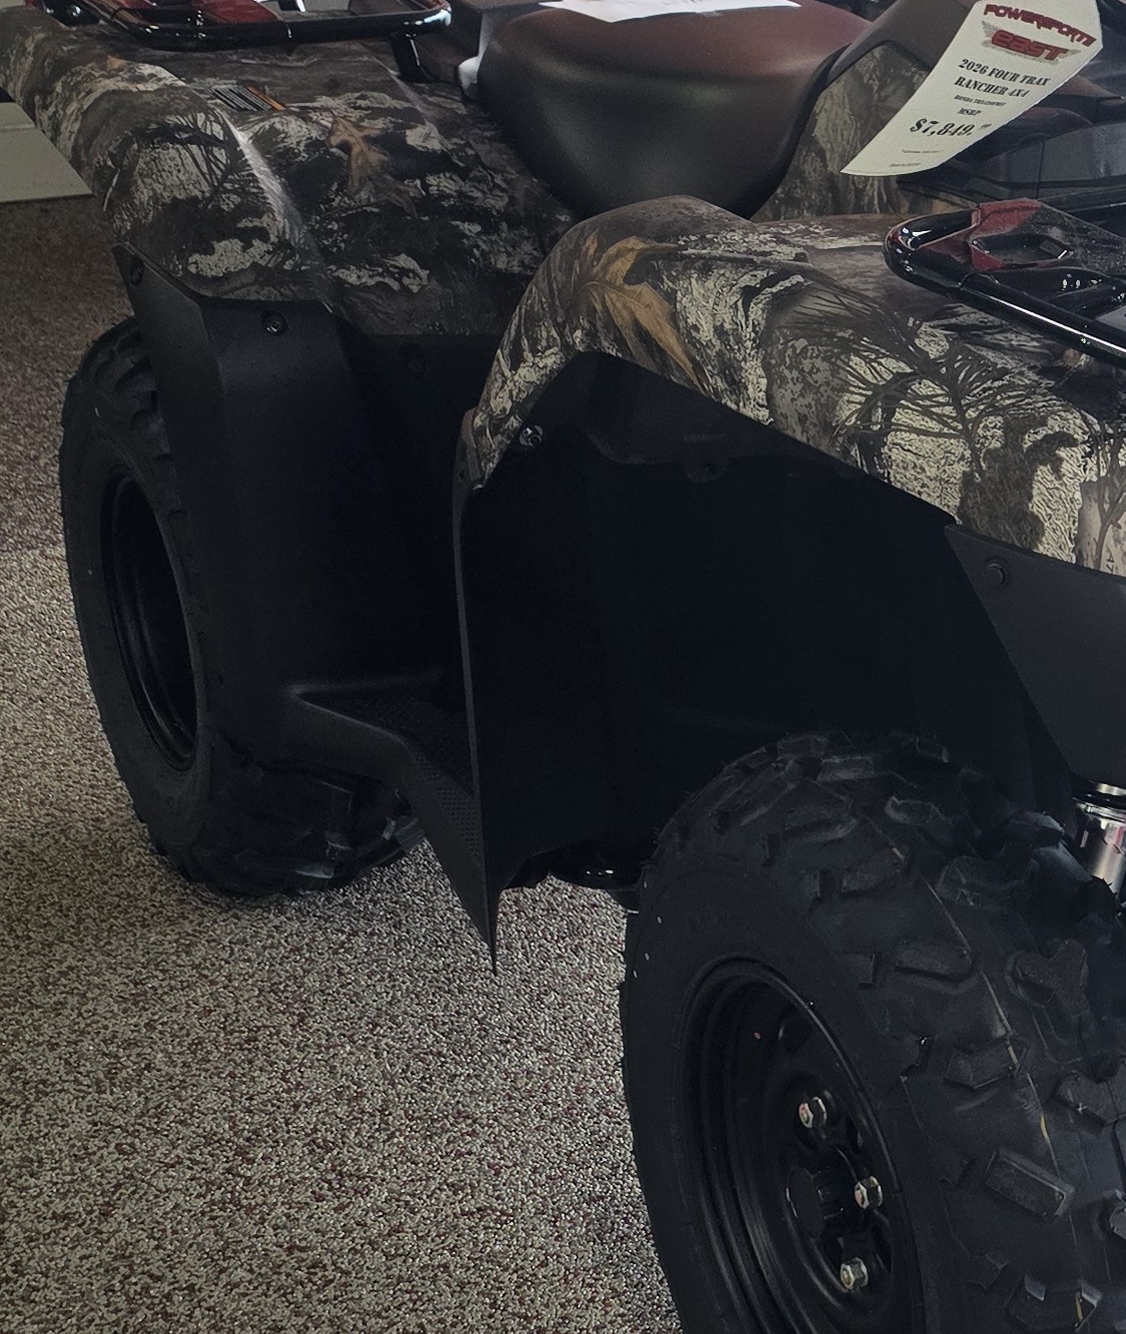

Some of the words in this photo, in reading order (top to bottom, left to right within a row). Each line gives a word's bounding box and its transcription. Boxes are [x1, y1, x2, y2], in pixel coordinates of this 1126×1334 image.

[958, 58, 989, 75] 2026
[987, 67, 1021, 84] FOUR
[1019, 74, 1051, 86] TRAX
[954, 76, 1009, 96] RANCHER
